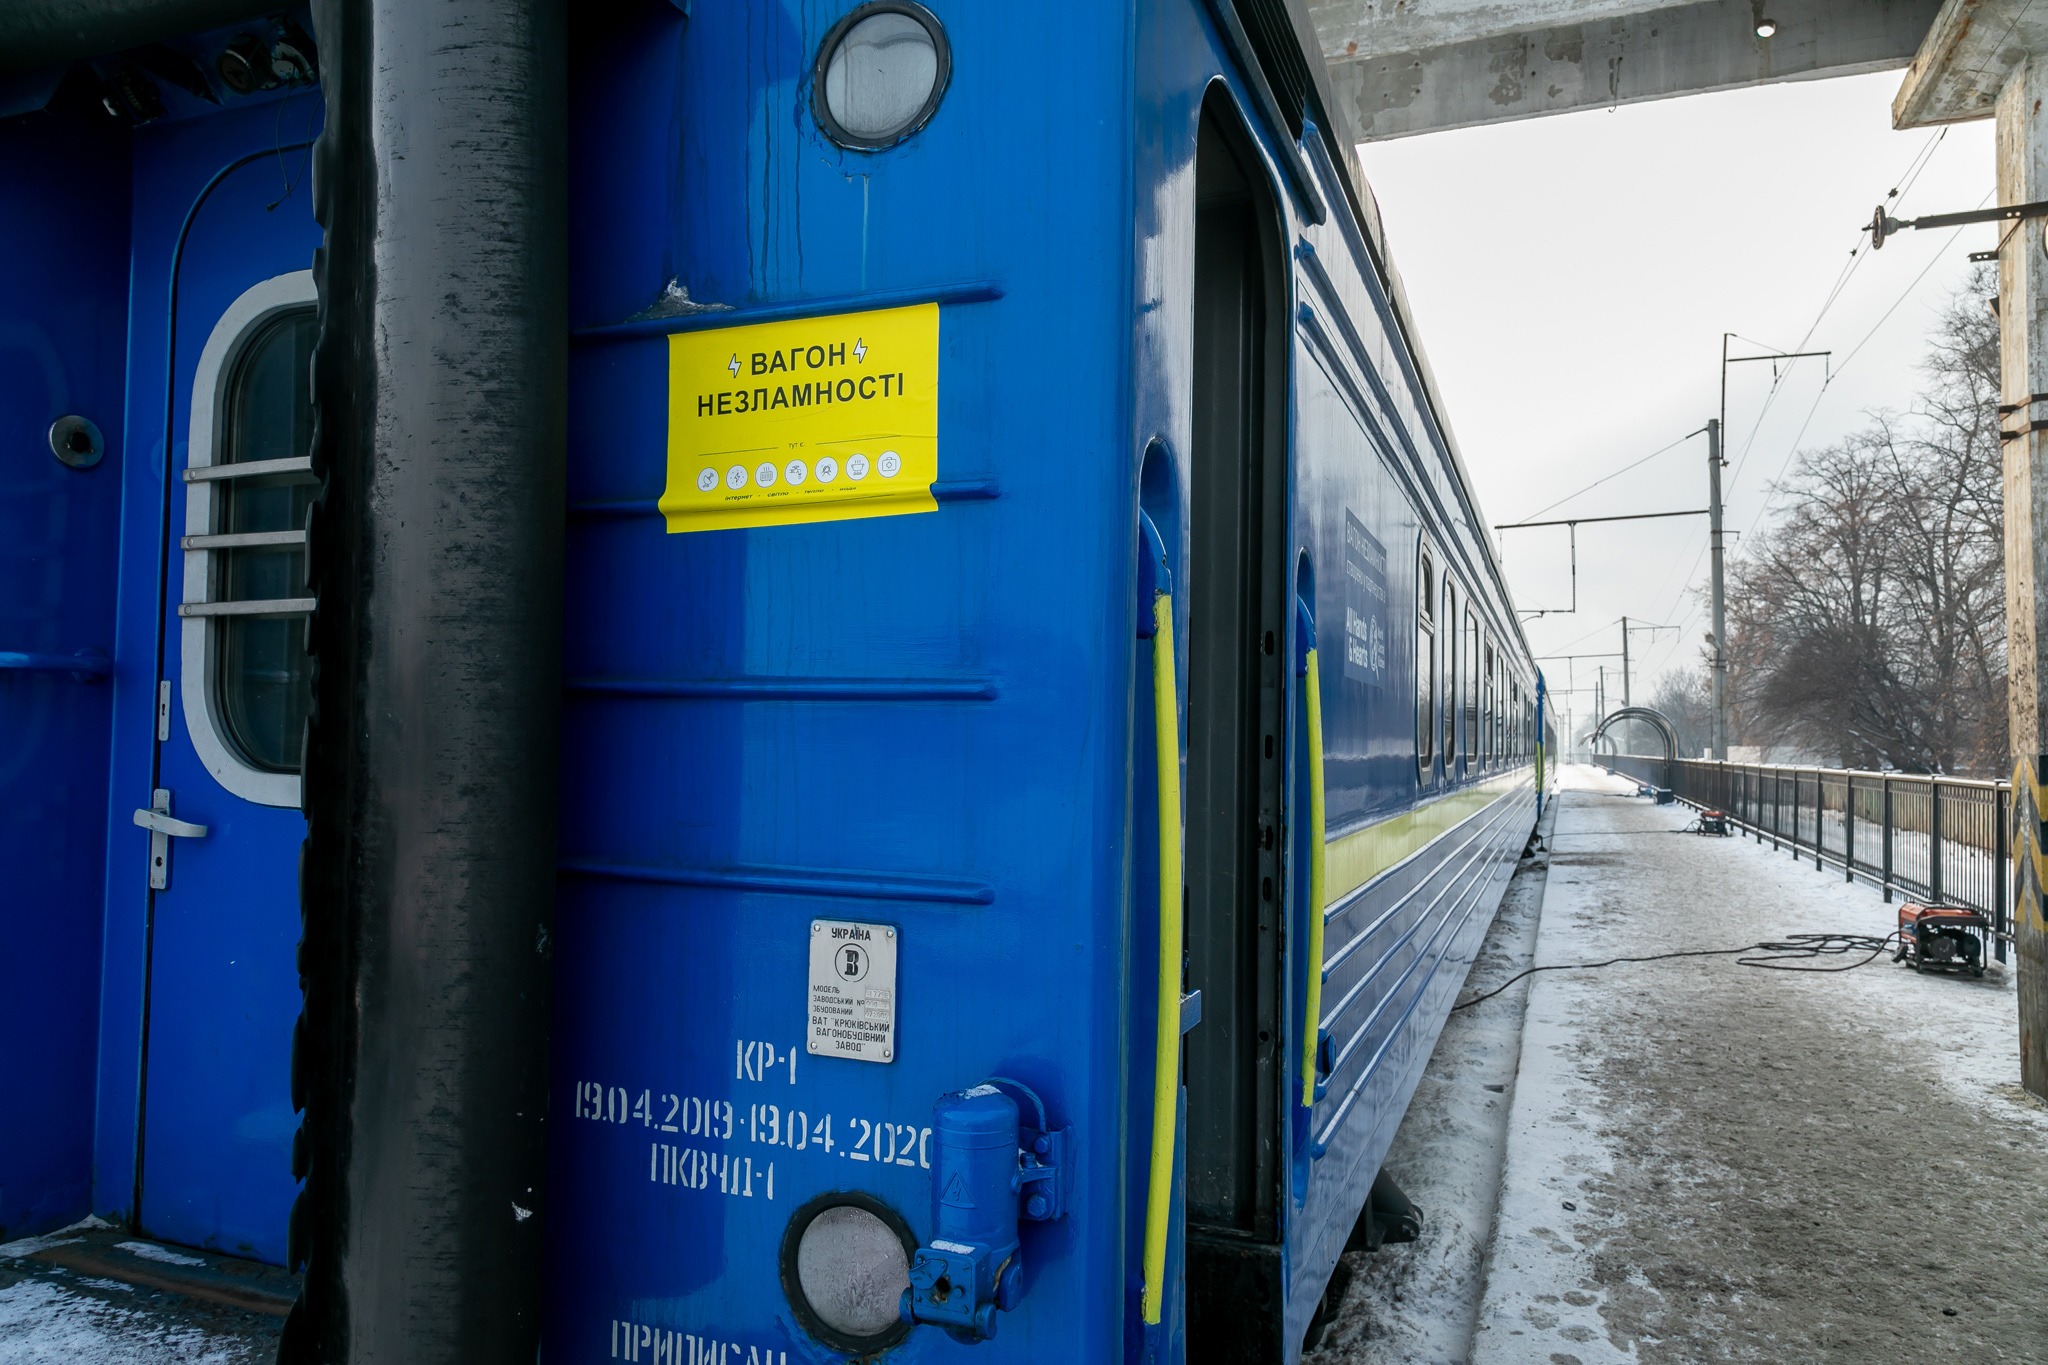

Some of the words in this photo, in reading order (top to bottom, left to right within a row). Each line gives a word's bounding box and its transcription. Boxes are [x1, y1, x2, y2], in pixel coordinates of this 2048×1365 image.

[751, 342, 846, 376] ВАГОН
[697, 372, 904, 418] НЕЗЛАМНОСТІ
[831, 926, 872, 941] УКРАЇНА
[813, 984, 841, 994] МОДЕЛЬ
[813, 994, 853, 1006] ЗАВОДСЬКИЙ
[813, 1004, 853, 1016] ЗБУДОВАНИЙ
[812, 1016, 828, 1026] ВАТ
[816, 1026, 886, 1043] ВАГОНОБУДІВНИЙ
[736, 1039, 797, 1085] КР-1
